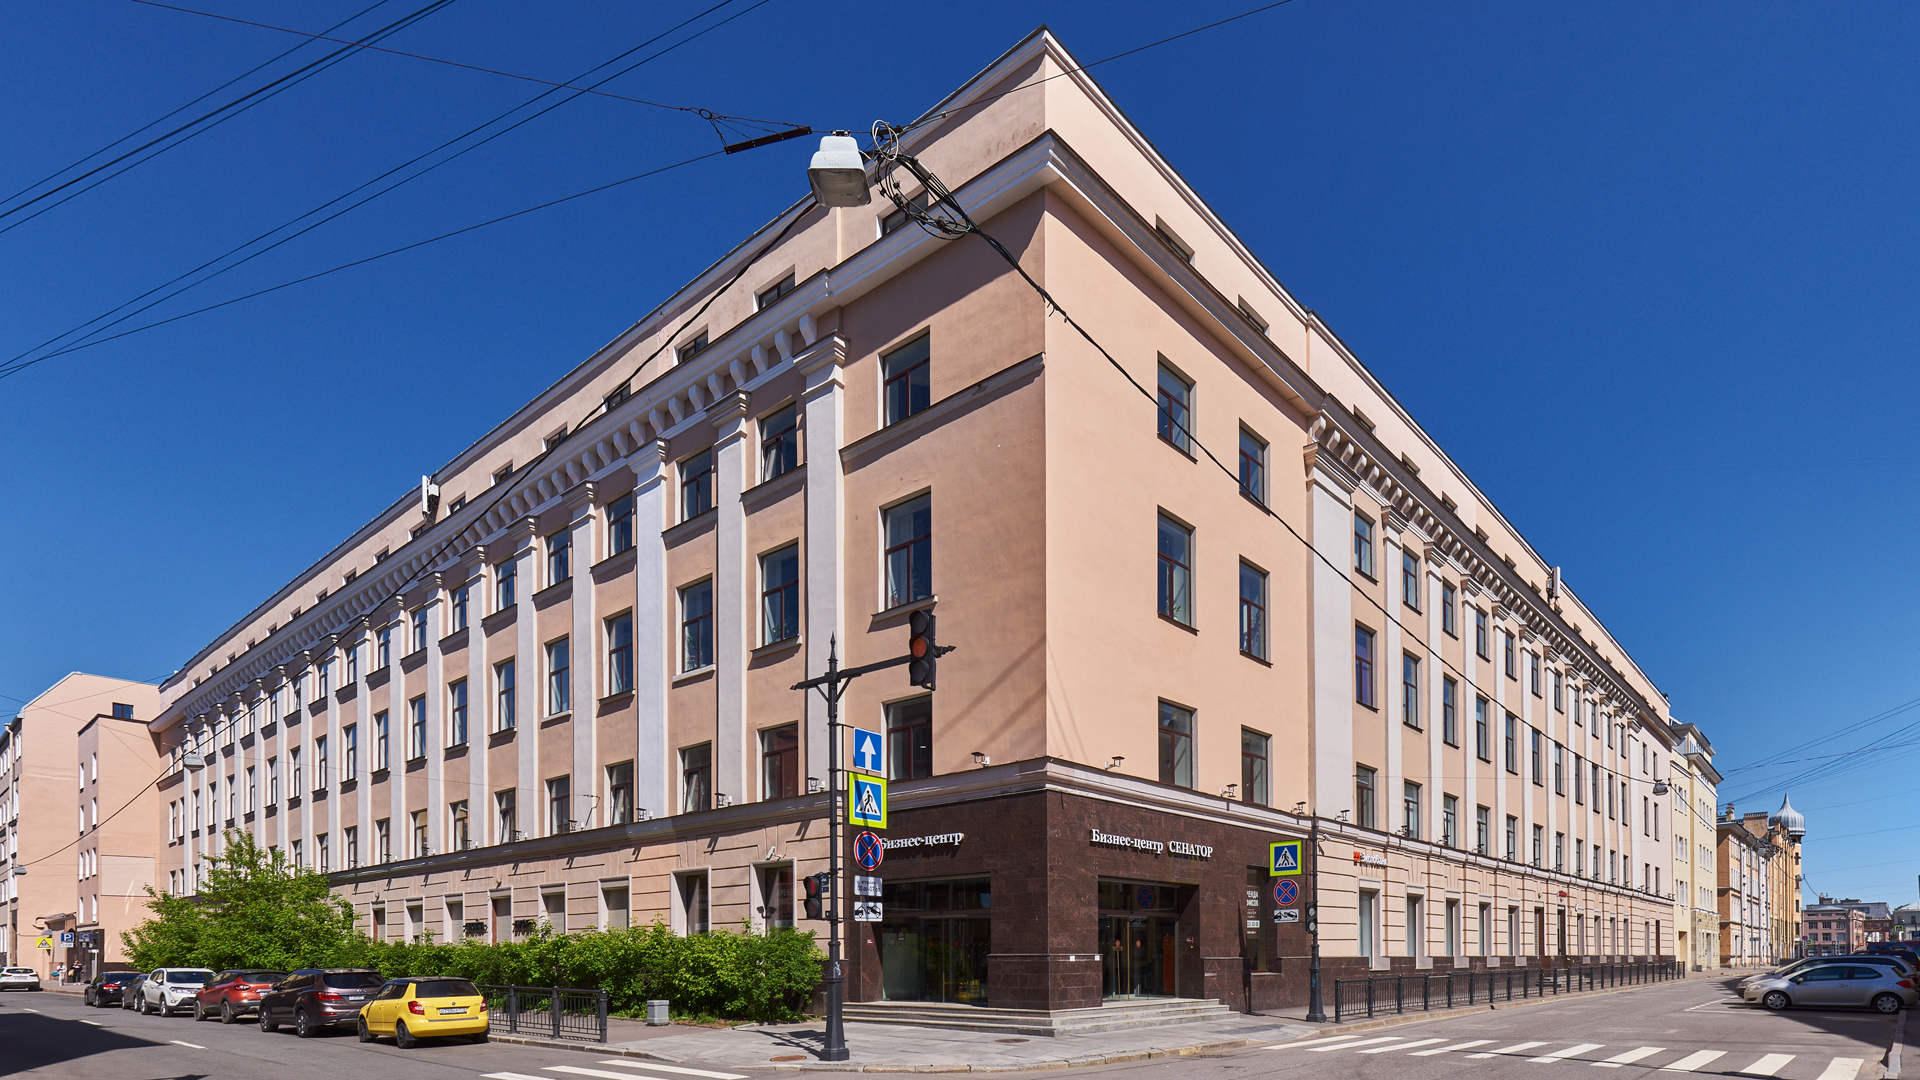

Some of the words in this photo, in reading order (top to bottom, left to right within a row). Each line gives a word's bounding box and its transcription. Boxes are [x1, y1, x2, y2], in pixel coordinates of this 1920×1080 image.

[880, 832, 963, 850] Бизнес-центр
[1091, 828, 1164, 854] Бизнес-центр
[1168, 840, 1214, 858] СЕНАТОР
[1246, 890, 1259, 899] РЕНДА
